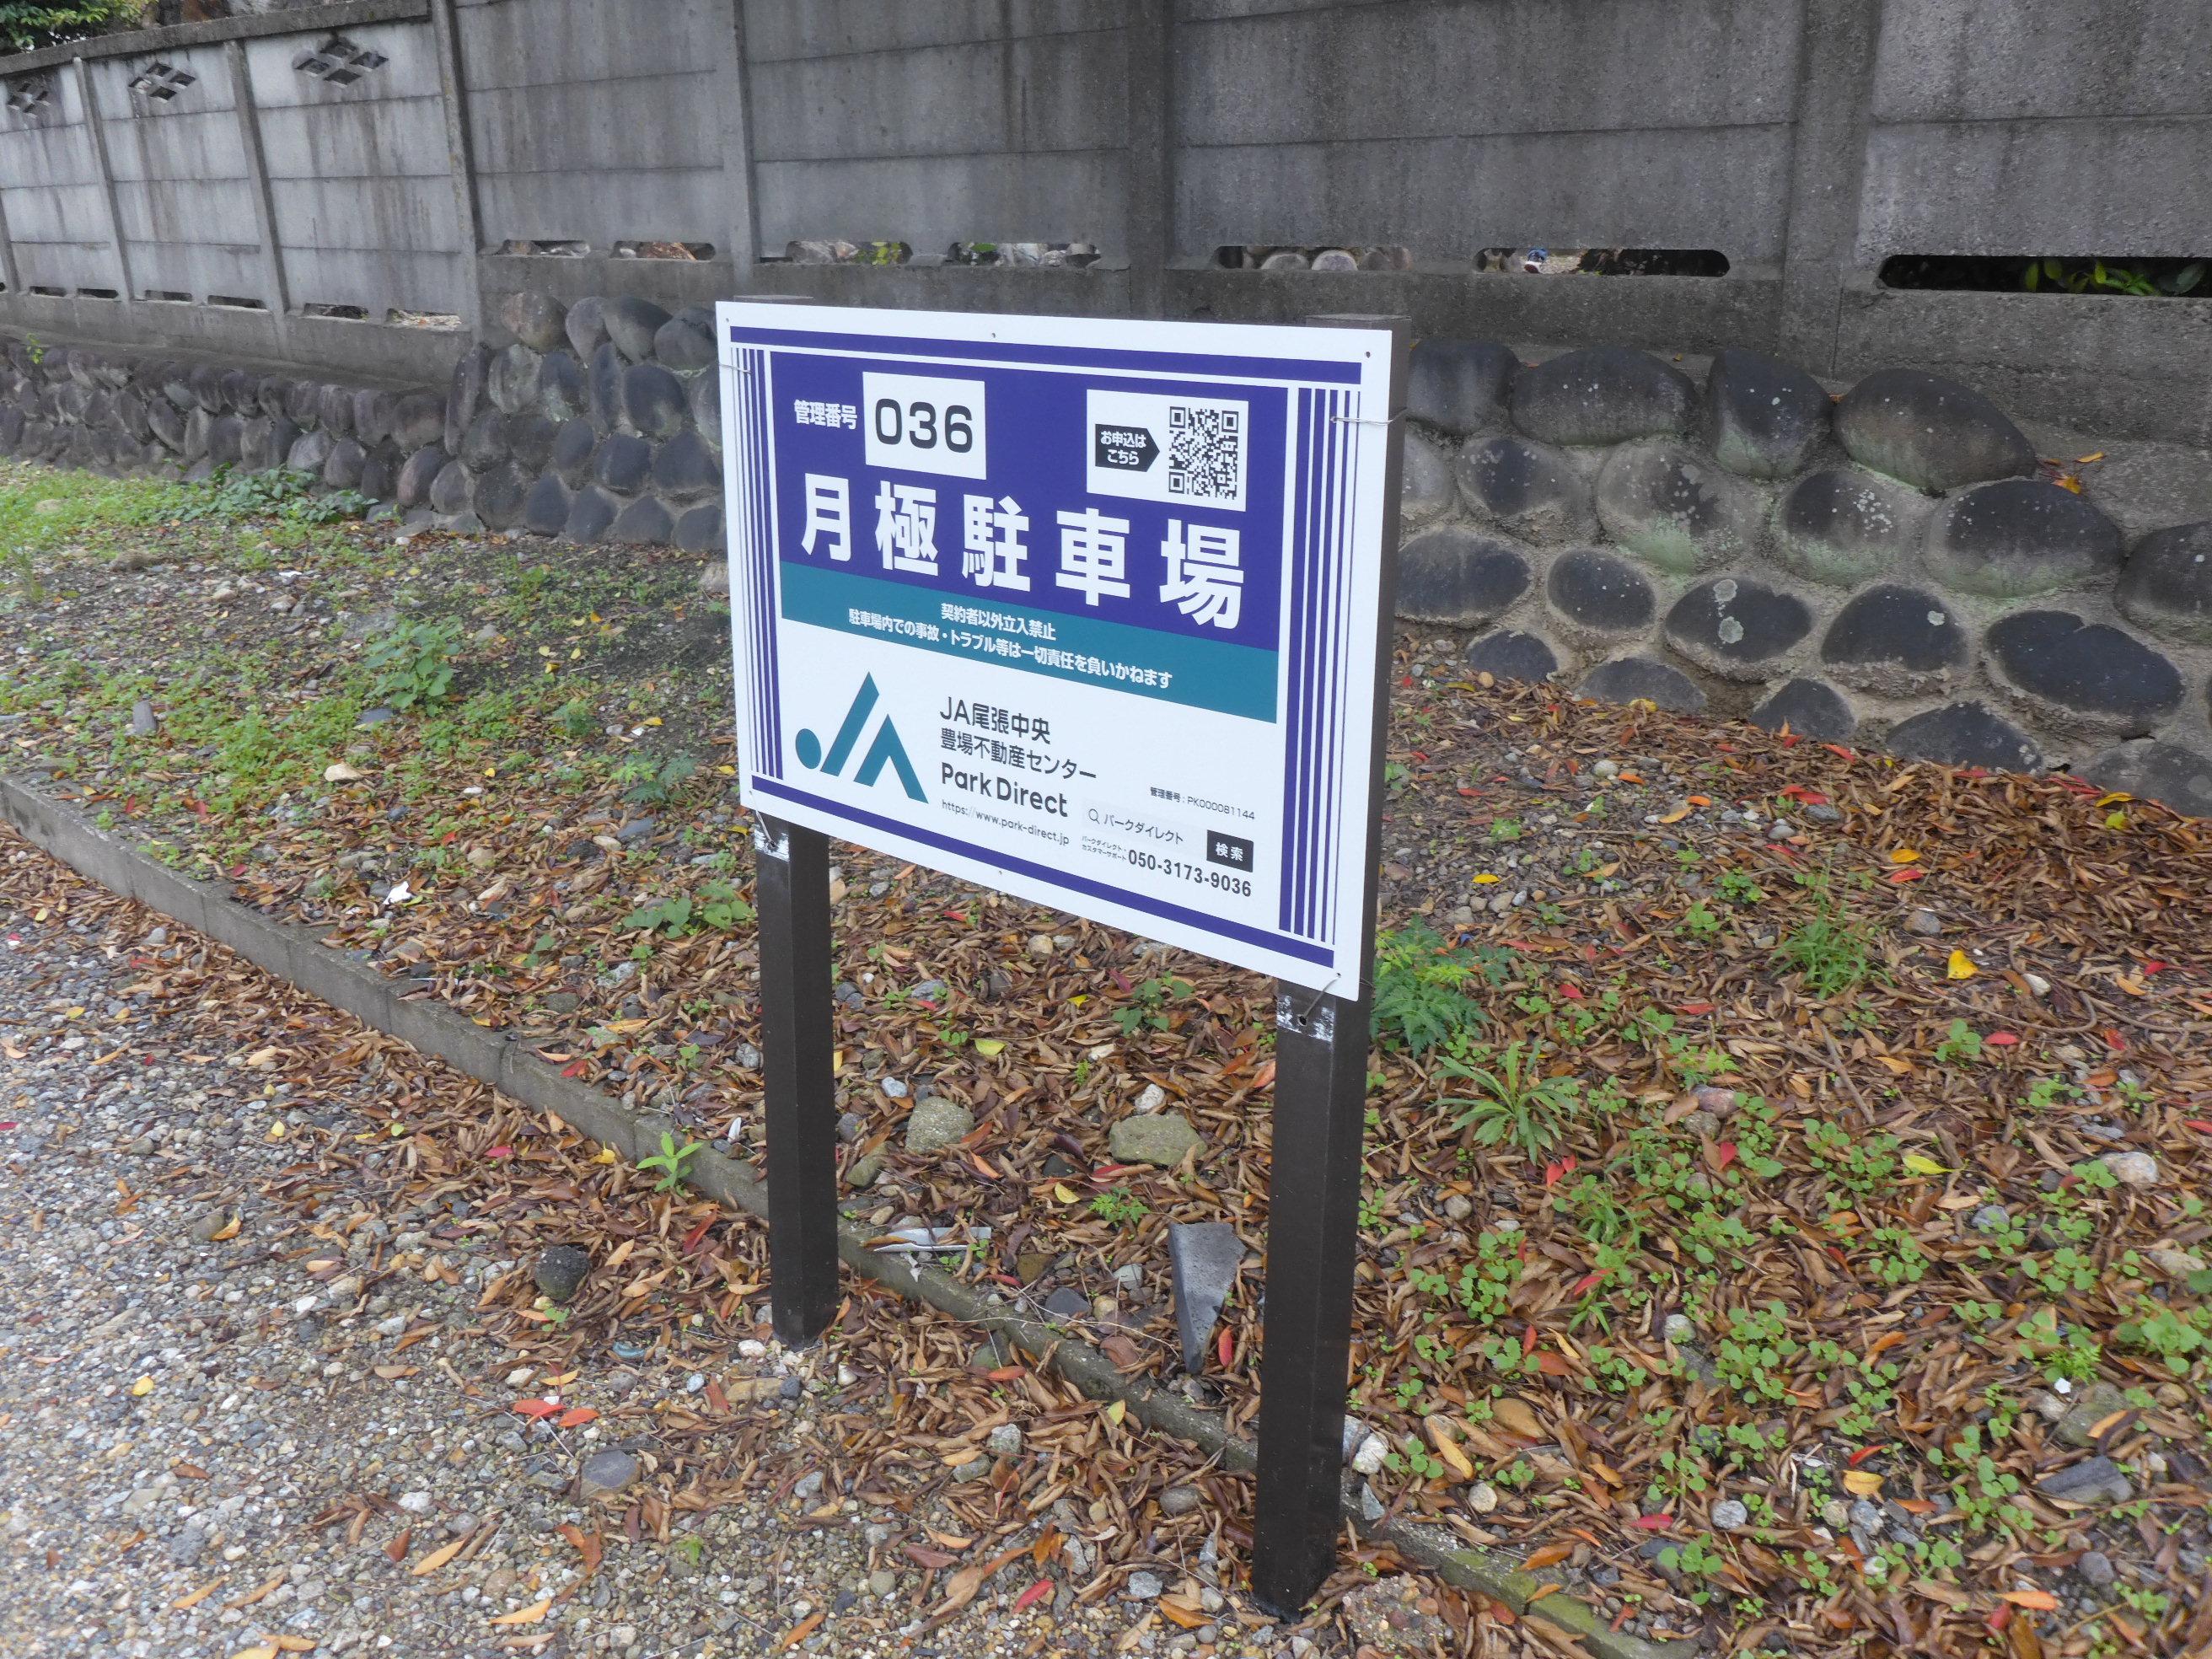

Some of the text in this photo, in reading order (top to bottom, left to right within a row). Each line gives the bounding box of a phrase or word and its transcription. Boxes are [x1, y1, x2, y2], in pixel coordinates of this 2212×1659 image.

[794, 400, 857, 429] 管理番号
[875, 398, 973, 453] 036
[1101, 431, 1146, 448] お申込は
[1108, 449, 1139, 464] こちら
[802, 473, 1244, 629] 月極駐車場
[941, 603, 1056, 642] 契約者以外立入禁止
[848, 608, 1173, 689] 駐車場内での事故・トラブル等は一切責任を負いかねます
[941, 727, 1097, 779] 豊場不動産センター
[942, 762, 1068, 818] Park Direct
[942, 799, 1070, 845] https://www.park-direct.jp
[1104, 813, 1184, 844] パークダイレクト
[1128, 849, 1252, 897] 050-3173-9036
[1216, 841, 1243, 862] 検索
